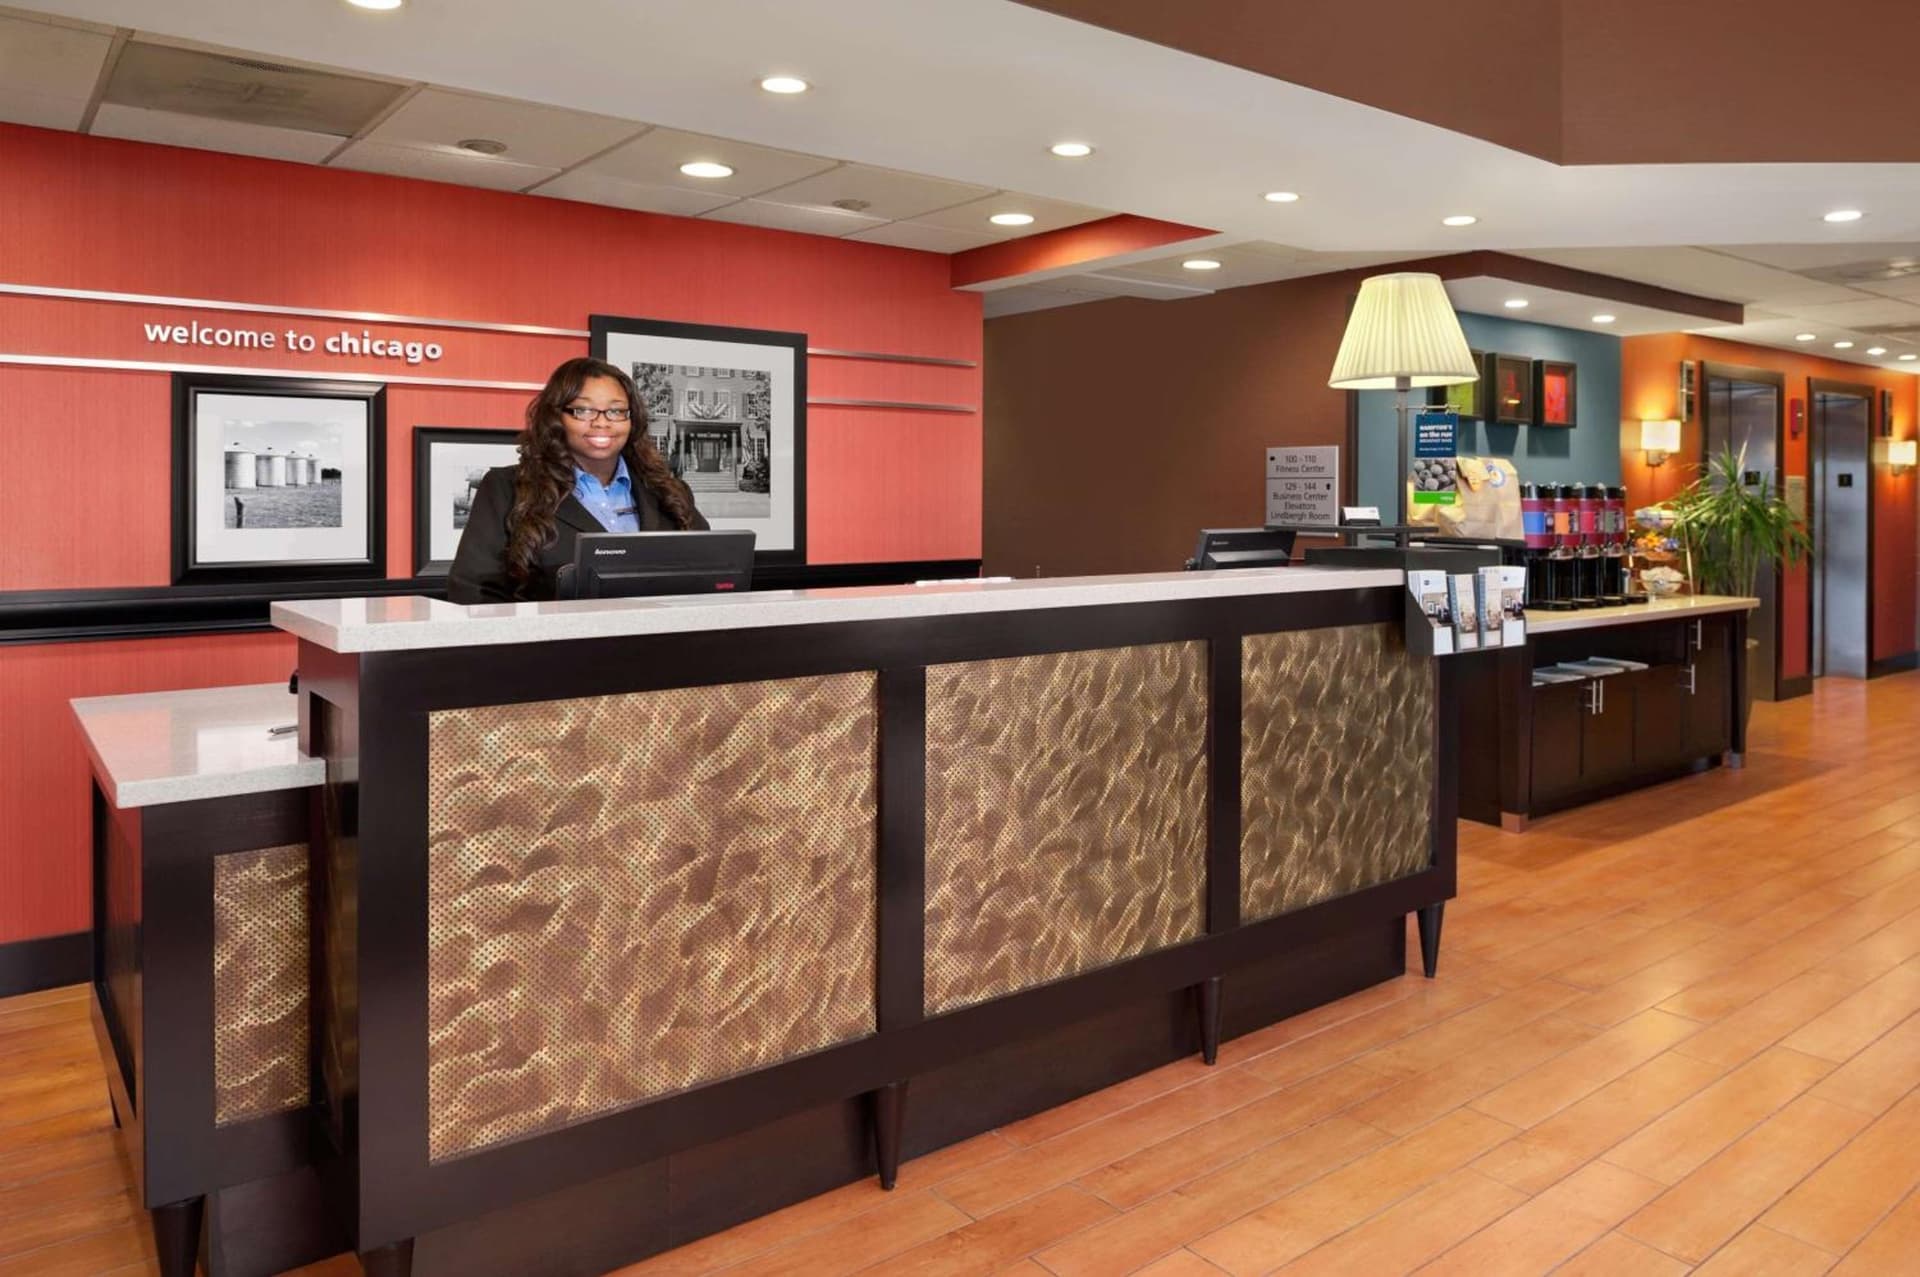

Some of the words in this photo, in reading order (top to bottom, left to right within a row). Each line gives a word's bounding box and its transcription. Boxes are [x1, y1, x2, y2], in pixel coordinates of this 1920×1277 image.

[144, 320, 276, 349] welcome
[285, 329, 316, 352] to
[325, 331, 443, 364] chicago
[1285, 455, 1298, 463] 100
[1304, 455, 1317, 463] 110
[1275, 465, 1299, 473] Fitness
[1301, 464, 1325, 473] Center
[1272, 492, 1301, 500] Business
[1303, 492, 1328, 500] Center
[1284, 502, 1316, 510] Elevators
[1271, 512, 1307, 522] Lindbergh
[1308, 512, 1331, 520] Room
